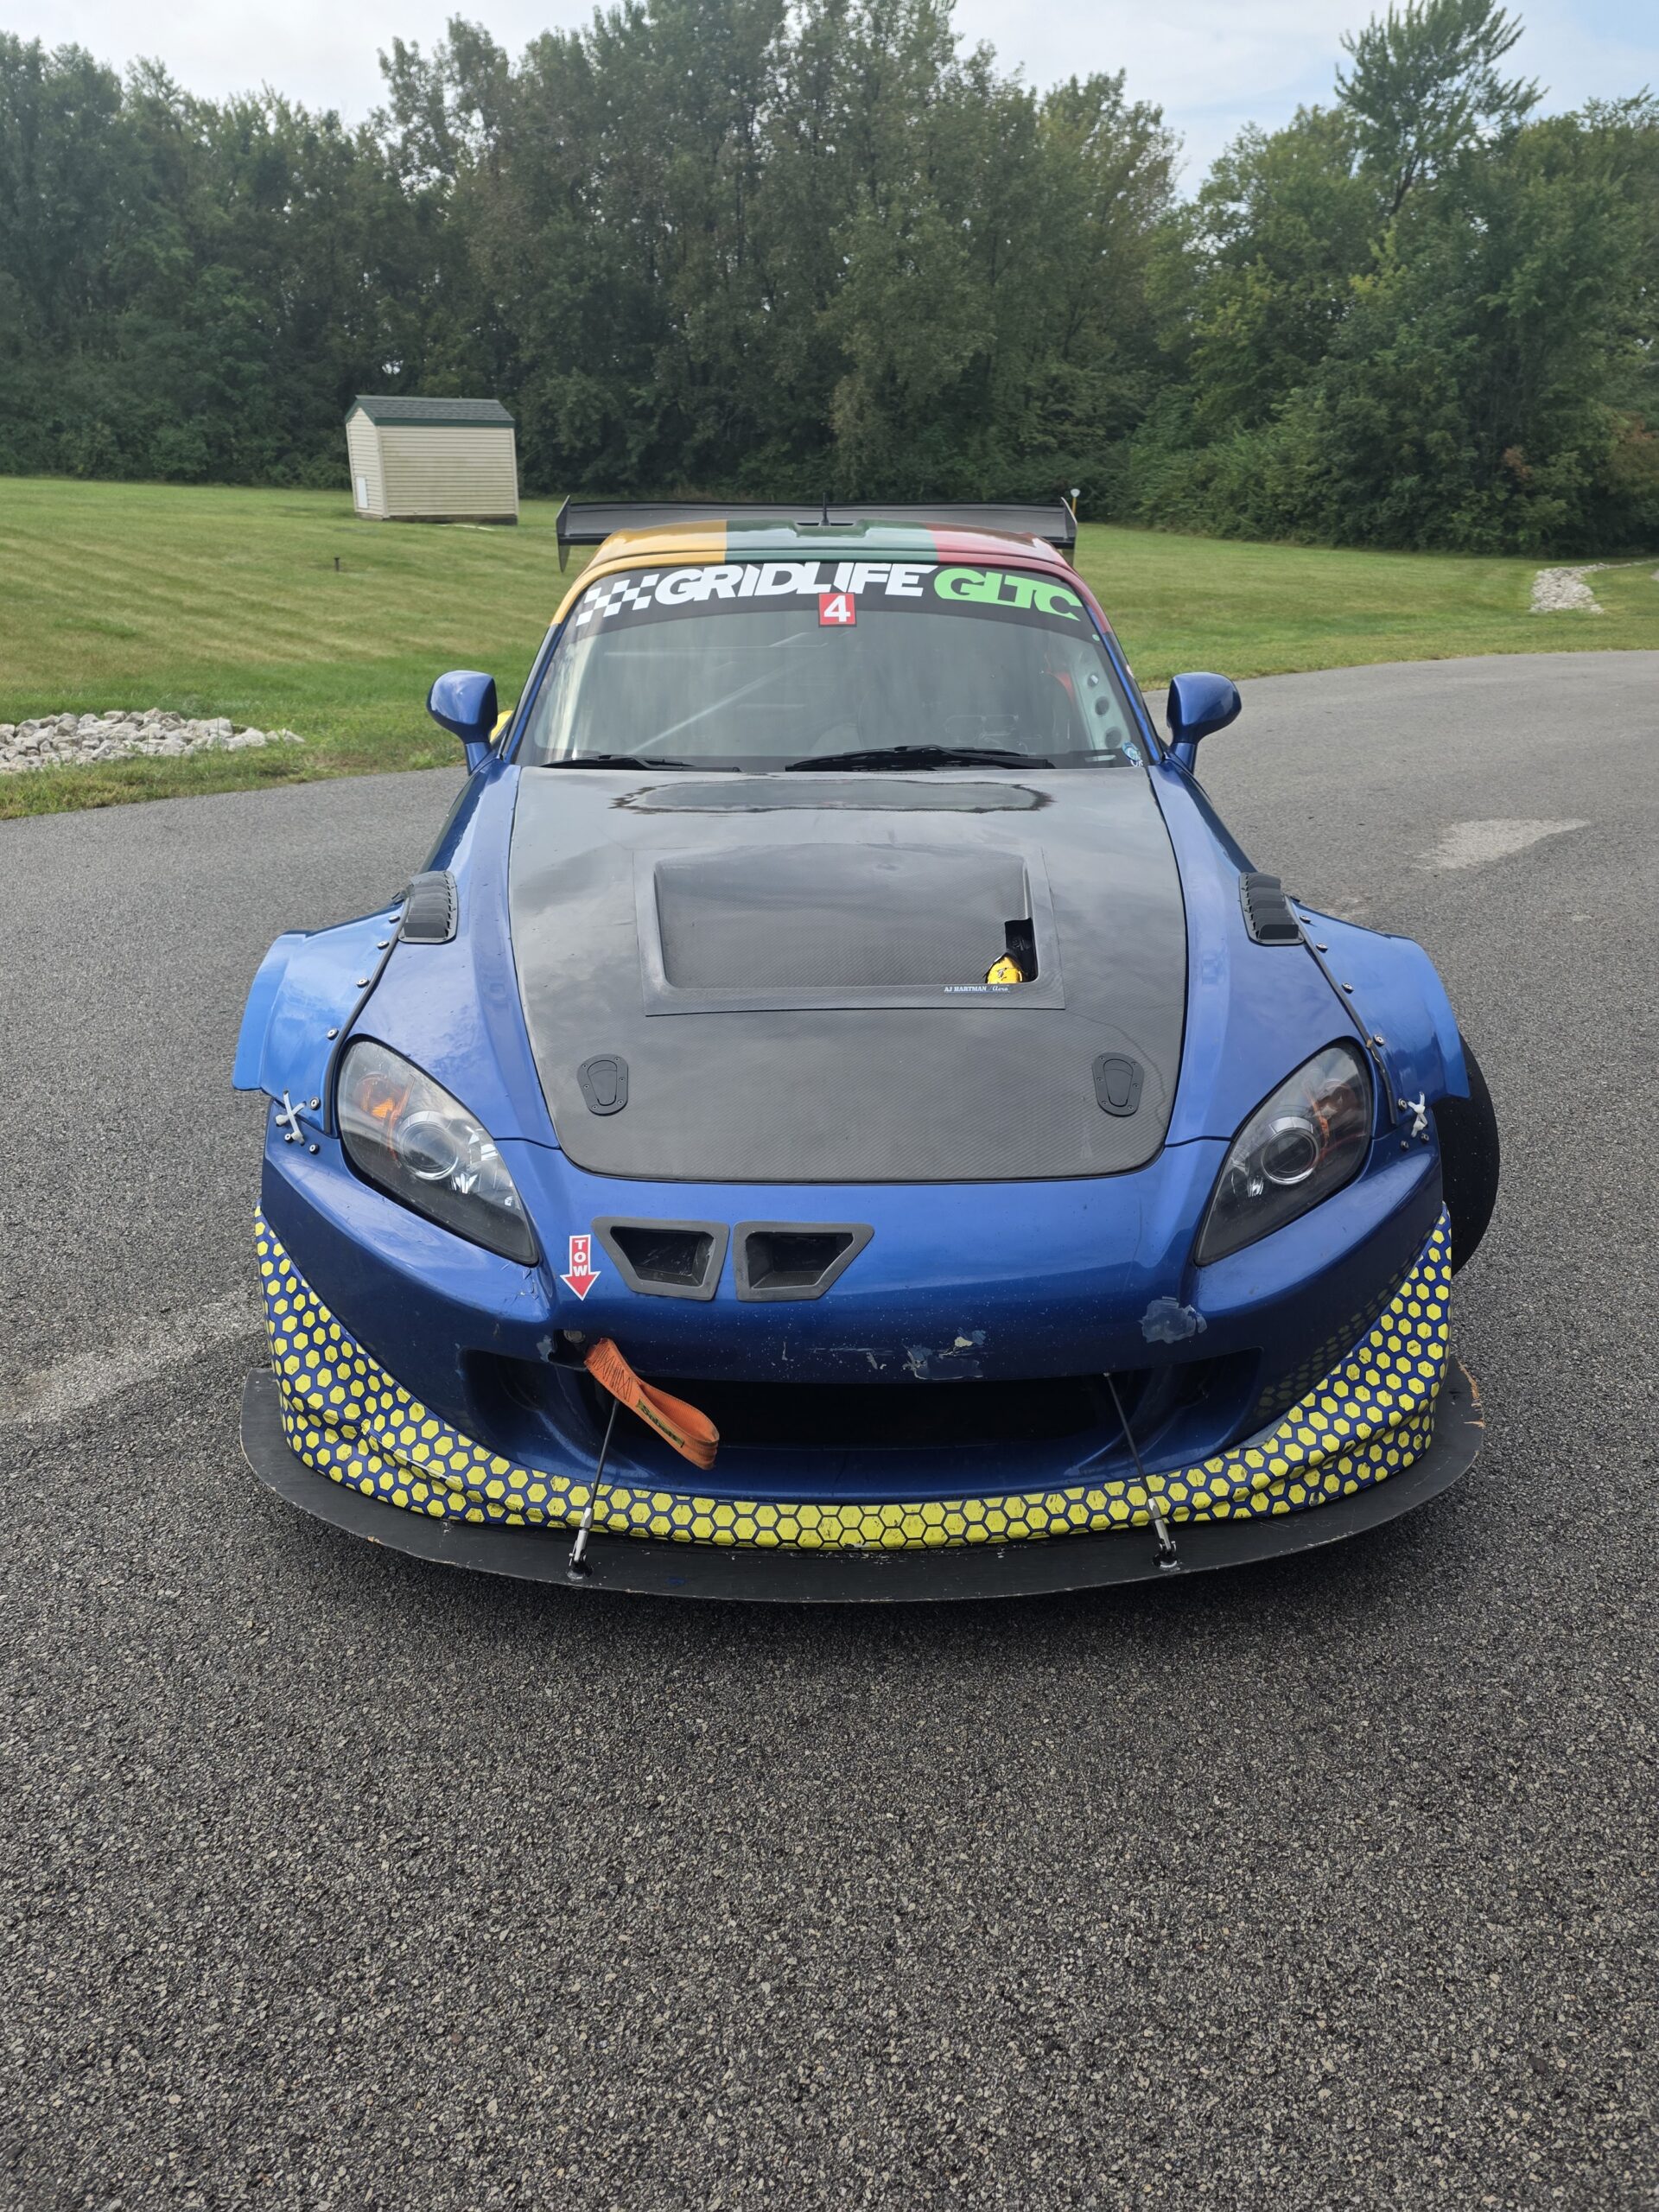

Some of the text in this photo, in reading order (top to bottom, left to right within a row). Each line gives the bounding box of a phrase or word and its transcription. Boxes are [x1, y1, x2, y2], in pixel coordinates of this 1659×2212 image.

[655, 562, 1082, 621] GRIDLIFE GLTC
[823, 594, 850, 622] 4
[573, 1239, 588, 1277] TOW
